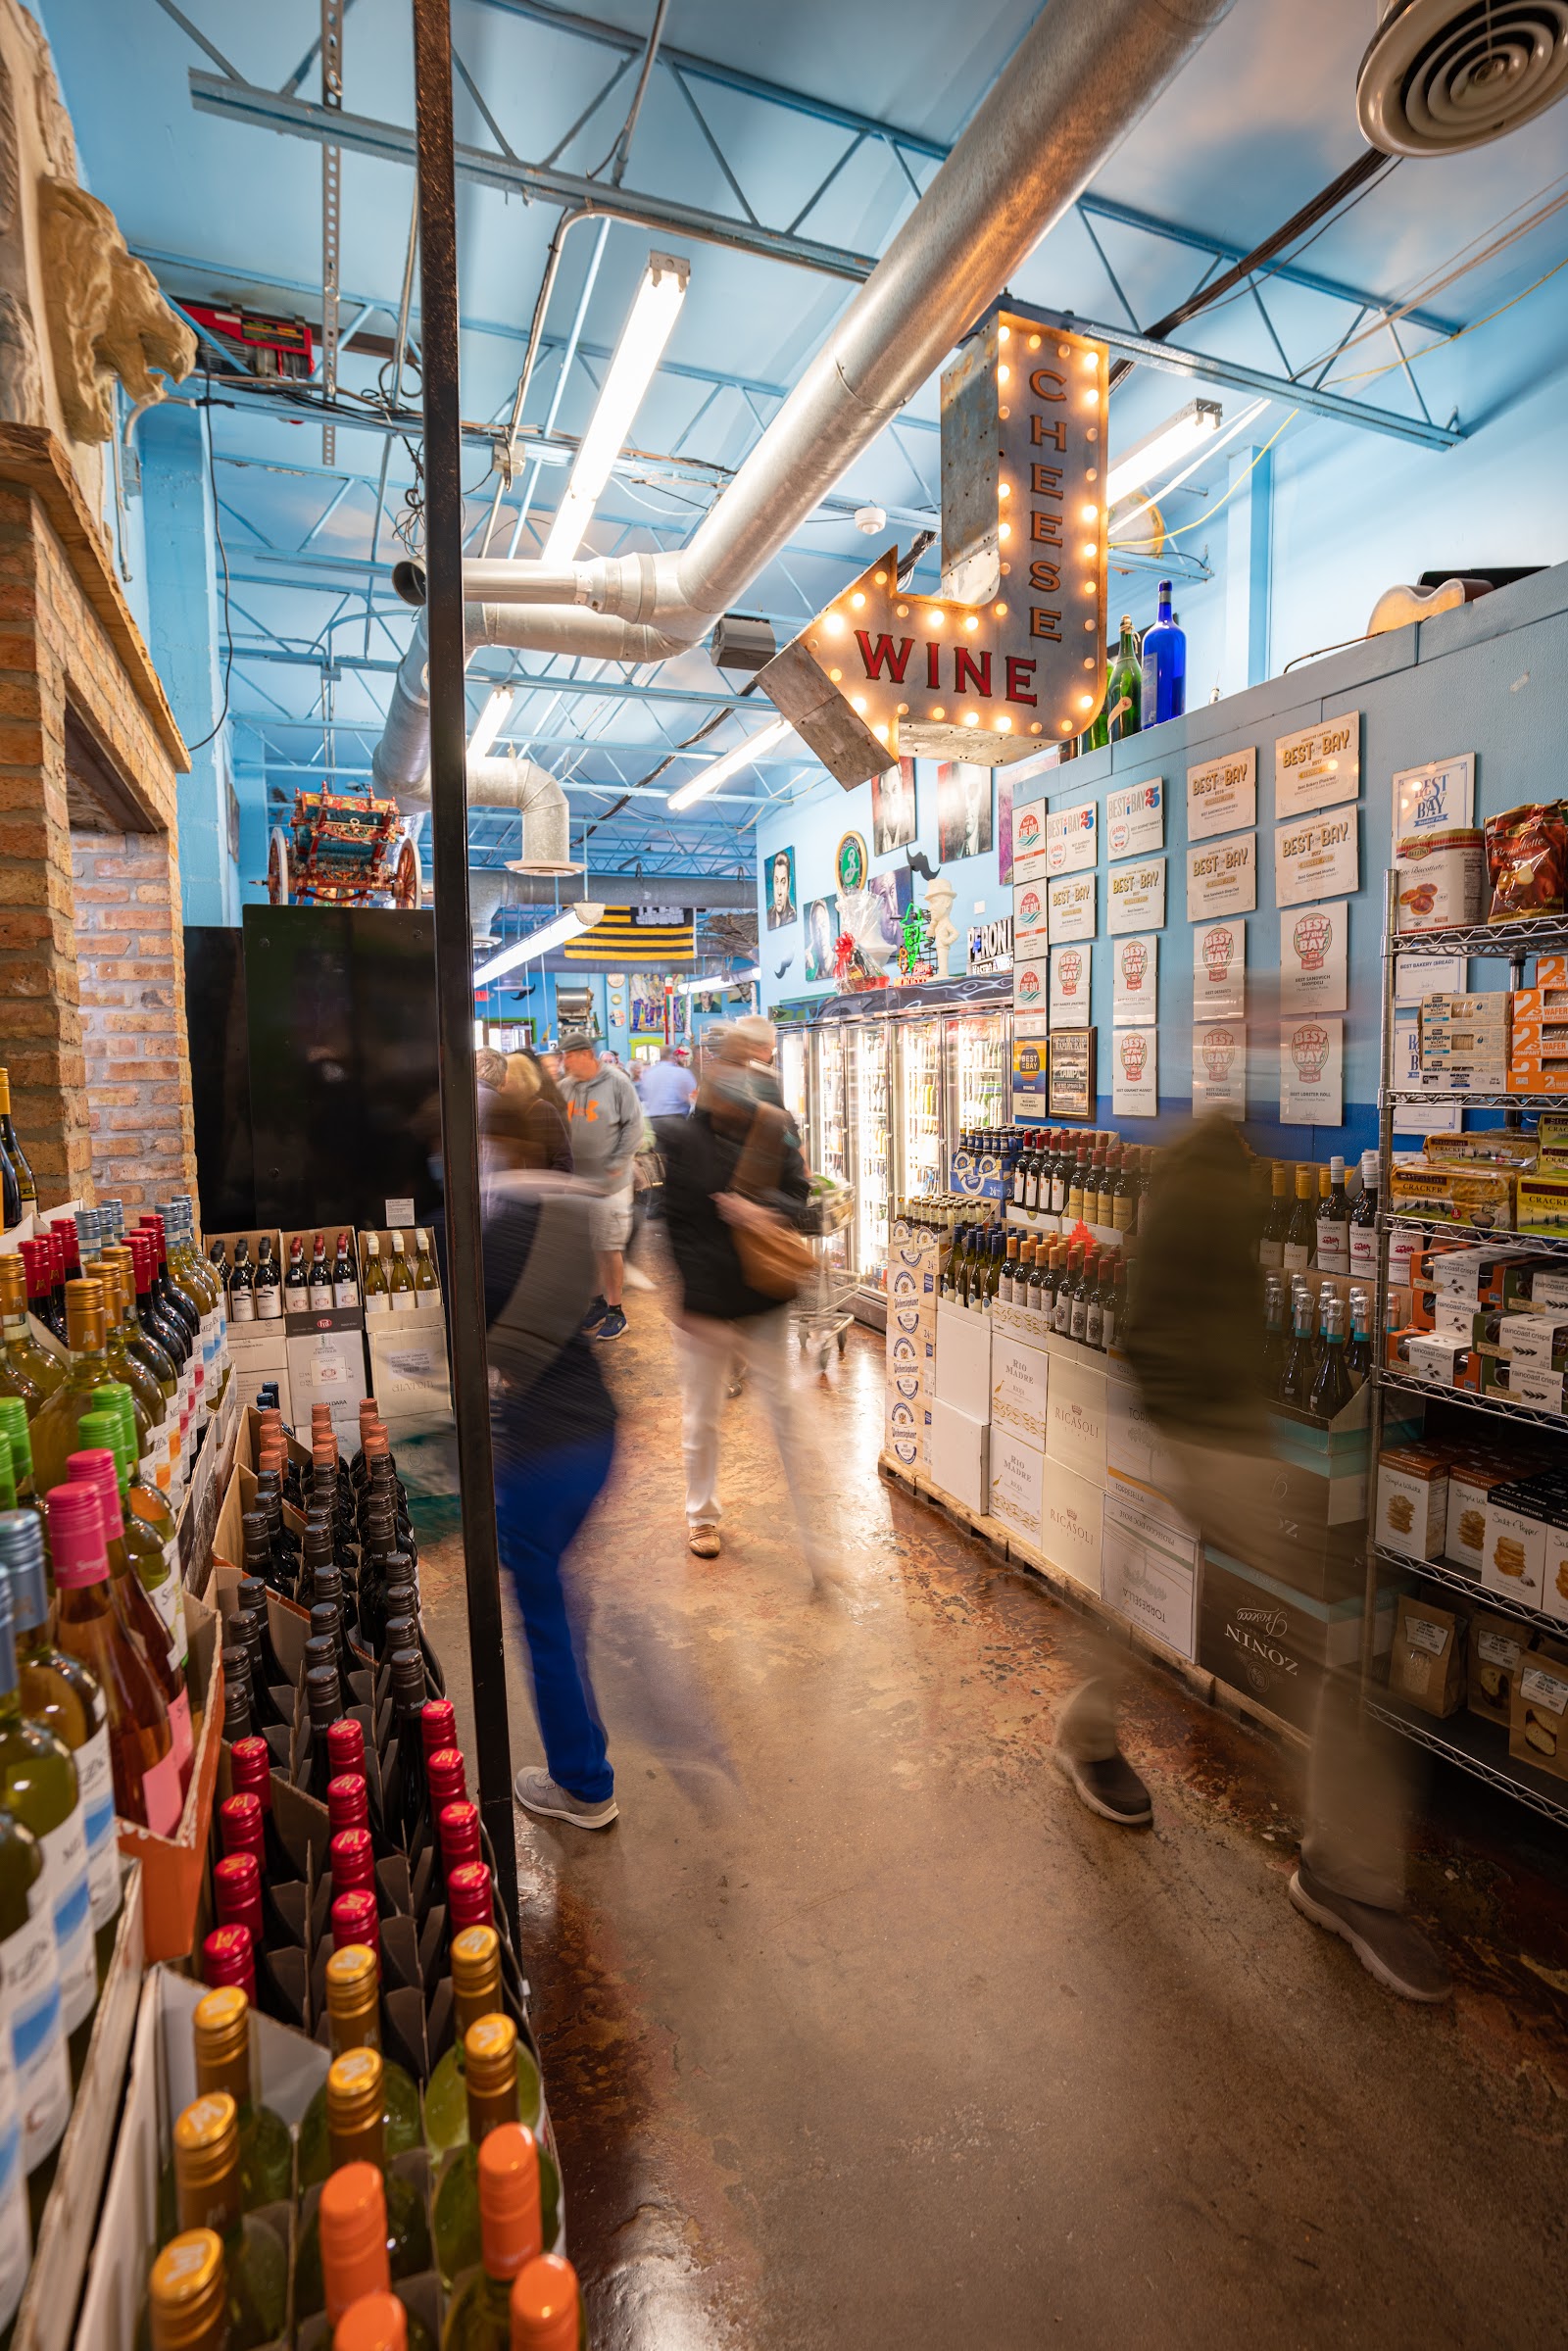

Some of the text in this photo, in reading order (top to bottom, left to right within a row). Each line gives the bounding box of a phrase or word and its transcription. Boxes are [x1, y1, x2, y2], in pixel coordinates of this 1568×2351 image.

[1029, 368, 1067, 643] CHEESE
[855, 629, 1038, 707] WINE
[1283, 729, 1350, 768] BEST BAY
[1193, 763, 1248, 796] BEST BAY
[1414, 773, 1449, 799] BEST
[1108, 786, 1160, 819] BEST BAY 25
[1417, 797, 1446, 819] BAY
[1020, 823, 1039, 838] THE BAY
[1047, 809, 1094, 840] BEST BAY 25
[1283, 821, 1348, 857] BEST BAY
[1194, 847, 1248, 877] BEST BAY
[1113, 871, 1159, 894] BEST BAY
[1053, 885, 1090, 906] BEST BAY
[1020, 903, 1040, 914] THE BAY
[1296, 918, 1331, 935] BEST
[967, 916, 1013, 961] PERONI
[1205, 932, 1232, 949] BEST
[1299, 938, 1326, 953] BAY
[1124, 946, 1147, 957] BEST
[1207, 951, 1229, 964] BAY
[1060, 955, 1081, 965] BEST
[1061, 969, 1078, 980] BAY
[1125, 962, 1144, 974] BAY
[1030, 982, 1039, 992] BAY
[1123, 1037, 1146, 1049] BEST
[1205, 1034, 1233, 1046] BEST
[1294, 1030, 1327, 1045] BEST
[1124, 1053, 1144, 1064] BAY
[1207, 1053, 1229, 1063] BAY
[1297, 1051, 1323, 1064] BAY
[990, 1187, 997, 1196] 24
[1402, 1184, 1443, 1194] CRACKER
[1436, 1263, 1460, 1272] raincoast
[1535, 1282, 1564, 1292] raincoast
[1437, 1301, 1461, 1310] raincoast
[1502, 1327, 1550, 1342] raincoast crisps
[1411, 1347, 1452, 1361] raincoast crisps
[1012, 1358, 1027, 1372] RIO
[1005, 1364, 1034, 1384] MADRE
[1511, 1370, 1561, 1386] raincoast crisps
[1012, 1385, 1025, 1396] RIOJA
[1054, 1406, 1099, 1438] RICASOLI
[1010, 1454, 1025, 1469] RIO
[1004, 1459, 1031, 1483] MADRE
[1010, 1480, 1023, 1493] RIOJA
[1385, 1474, 1401, 1488] Simple
[1115, 1483, 1145, 1503] TORRESELLA
[1455, 1489, 1475, 1502] Simple
[1491, 1495, 1544, 1517] STONEWALL KITCHEN
[1050, 1508, 1094, 1544] RICASOLI
[1492, 1512, 1511, 1526] Salt
[1122, 1587, 1166, 1624] TORRESELLA
[1237, 1608, 1288, 1638] Prosecco
[1224, 1623, 1298, 1676] ZONIN
